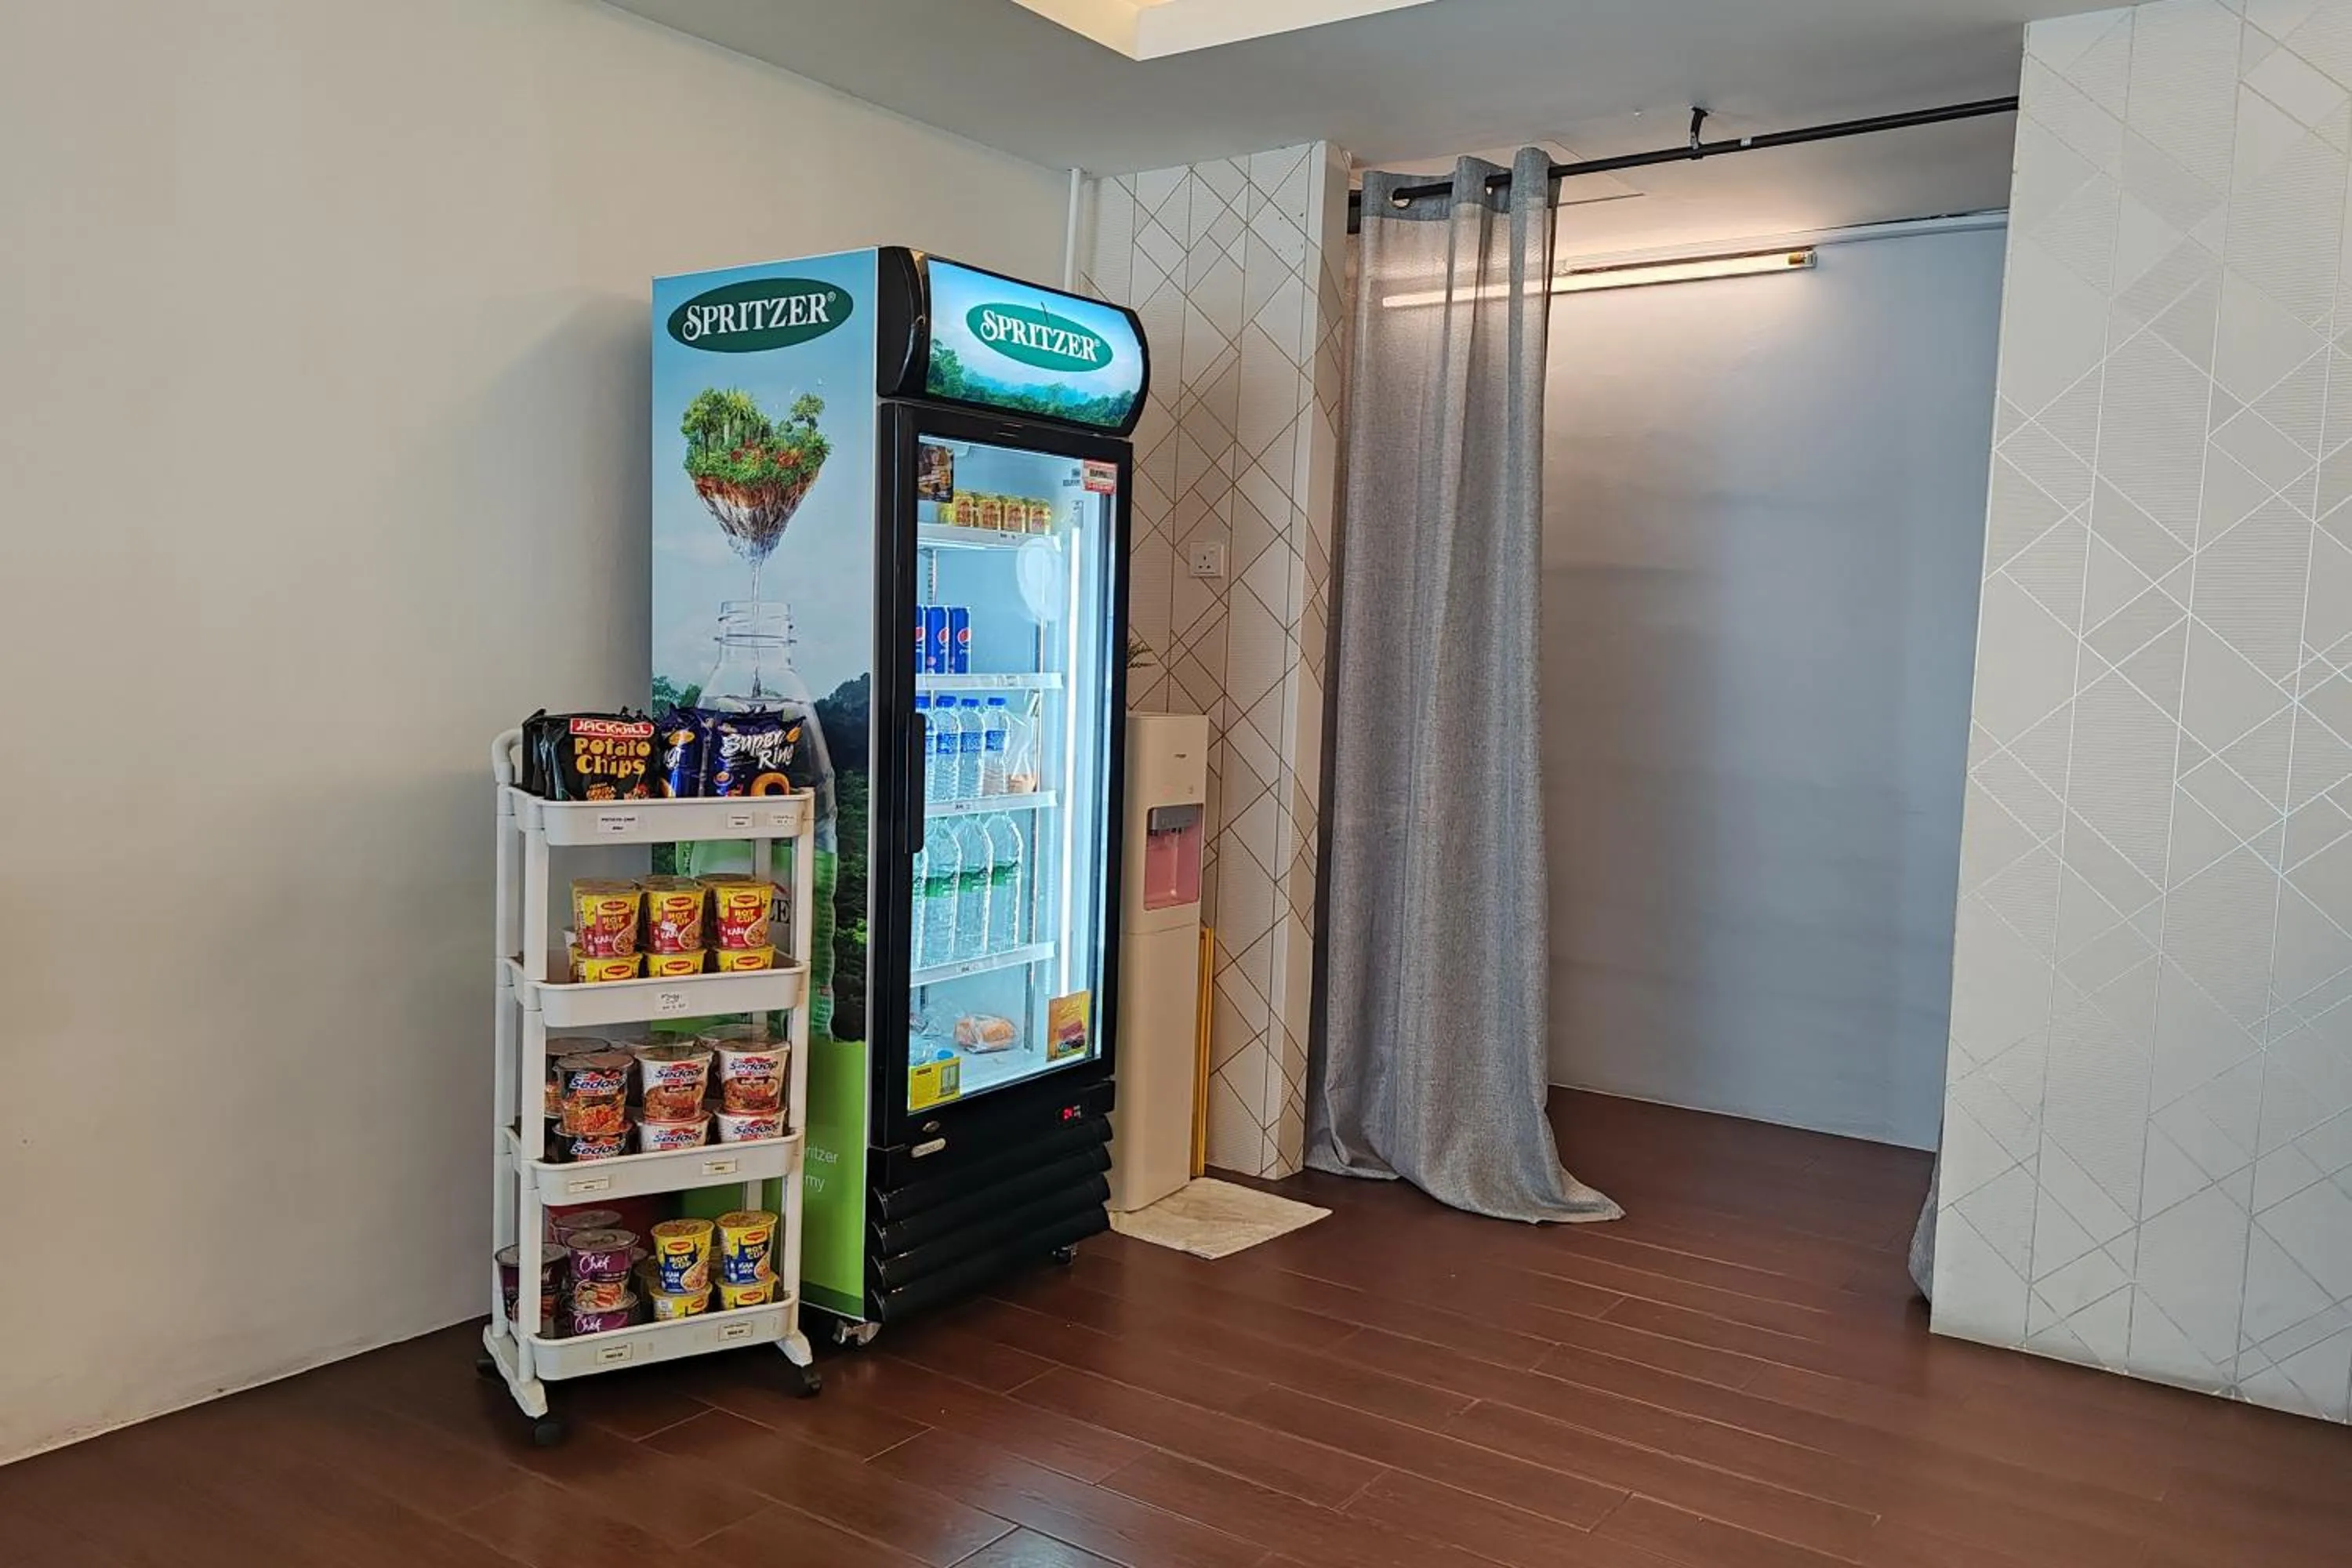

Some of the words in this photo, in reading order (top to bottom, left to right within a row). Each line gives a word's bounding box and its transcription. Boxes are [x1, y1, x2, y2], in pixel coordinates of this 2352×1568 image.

[981, 310, 1097, 362] SPRITZER
[575, 738, 651, 757] Potato
[720, 729, 786, 758] Super
[576, 754, 645, 779] Chips
[805, 1144, 839, 1164] ritzer
[579, 1255, 611, 1273] Chef
[575, 1316, 602, 1333] Chef
